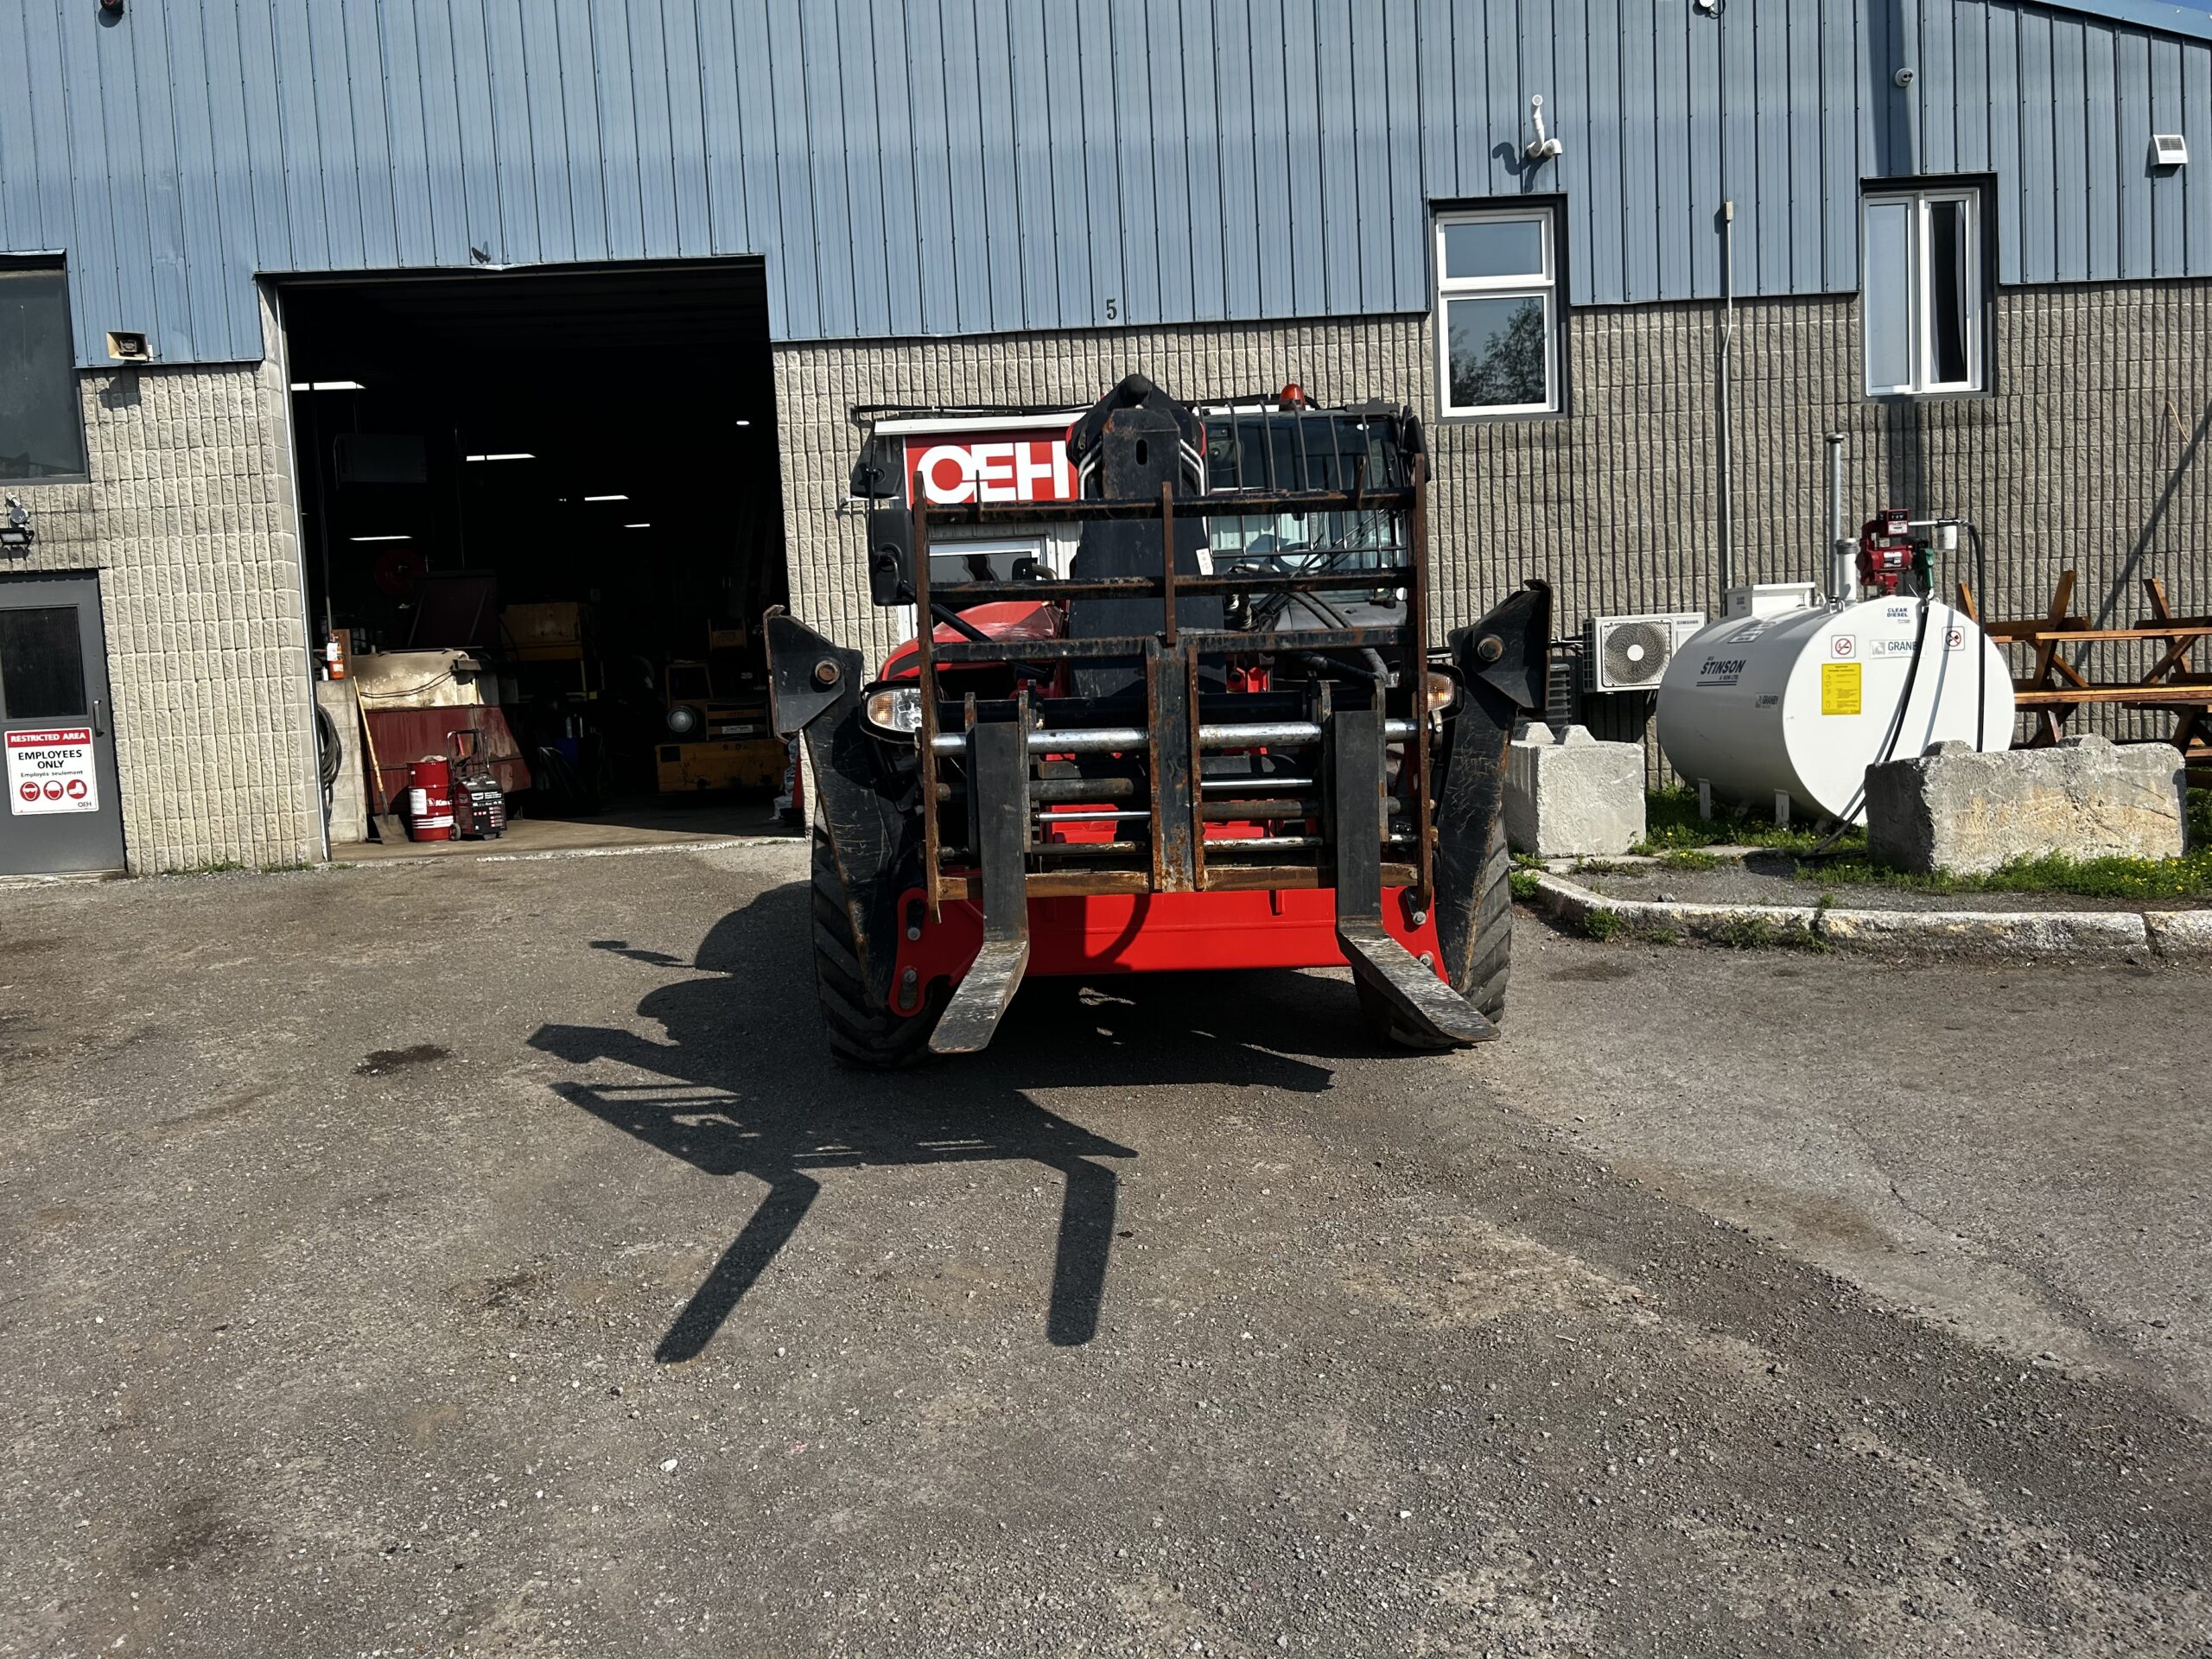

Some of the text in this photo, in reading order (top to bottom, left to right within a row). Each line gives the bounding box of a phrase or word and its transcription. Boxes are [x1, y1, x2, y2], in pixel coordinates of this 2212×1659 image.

[1106, 298, 1117, 320] 5
[917, 441, 1070, 504] OEH
[1887, 641, 1918, 652] GRANB
[1700, 659, 1746, 675] STINSON
[10, 732, 86, 743] RESTRICTED AREA
[18, 749, 82, 760] EMPLOYEES
[37, 760, 65, 769] ONLY
